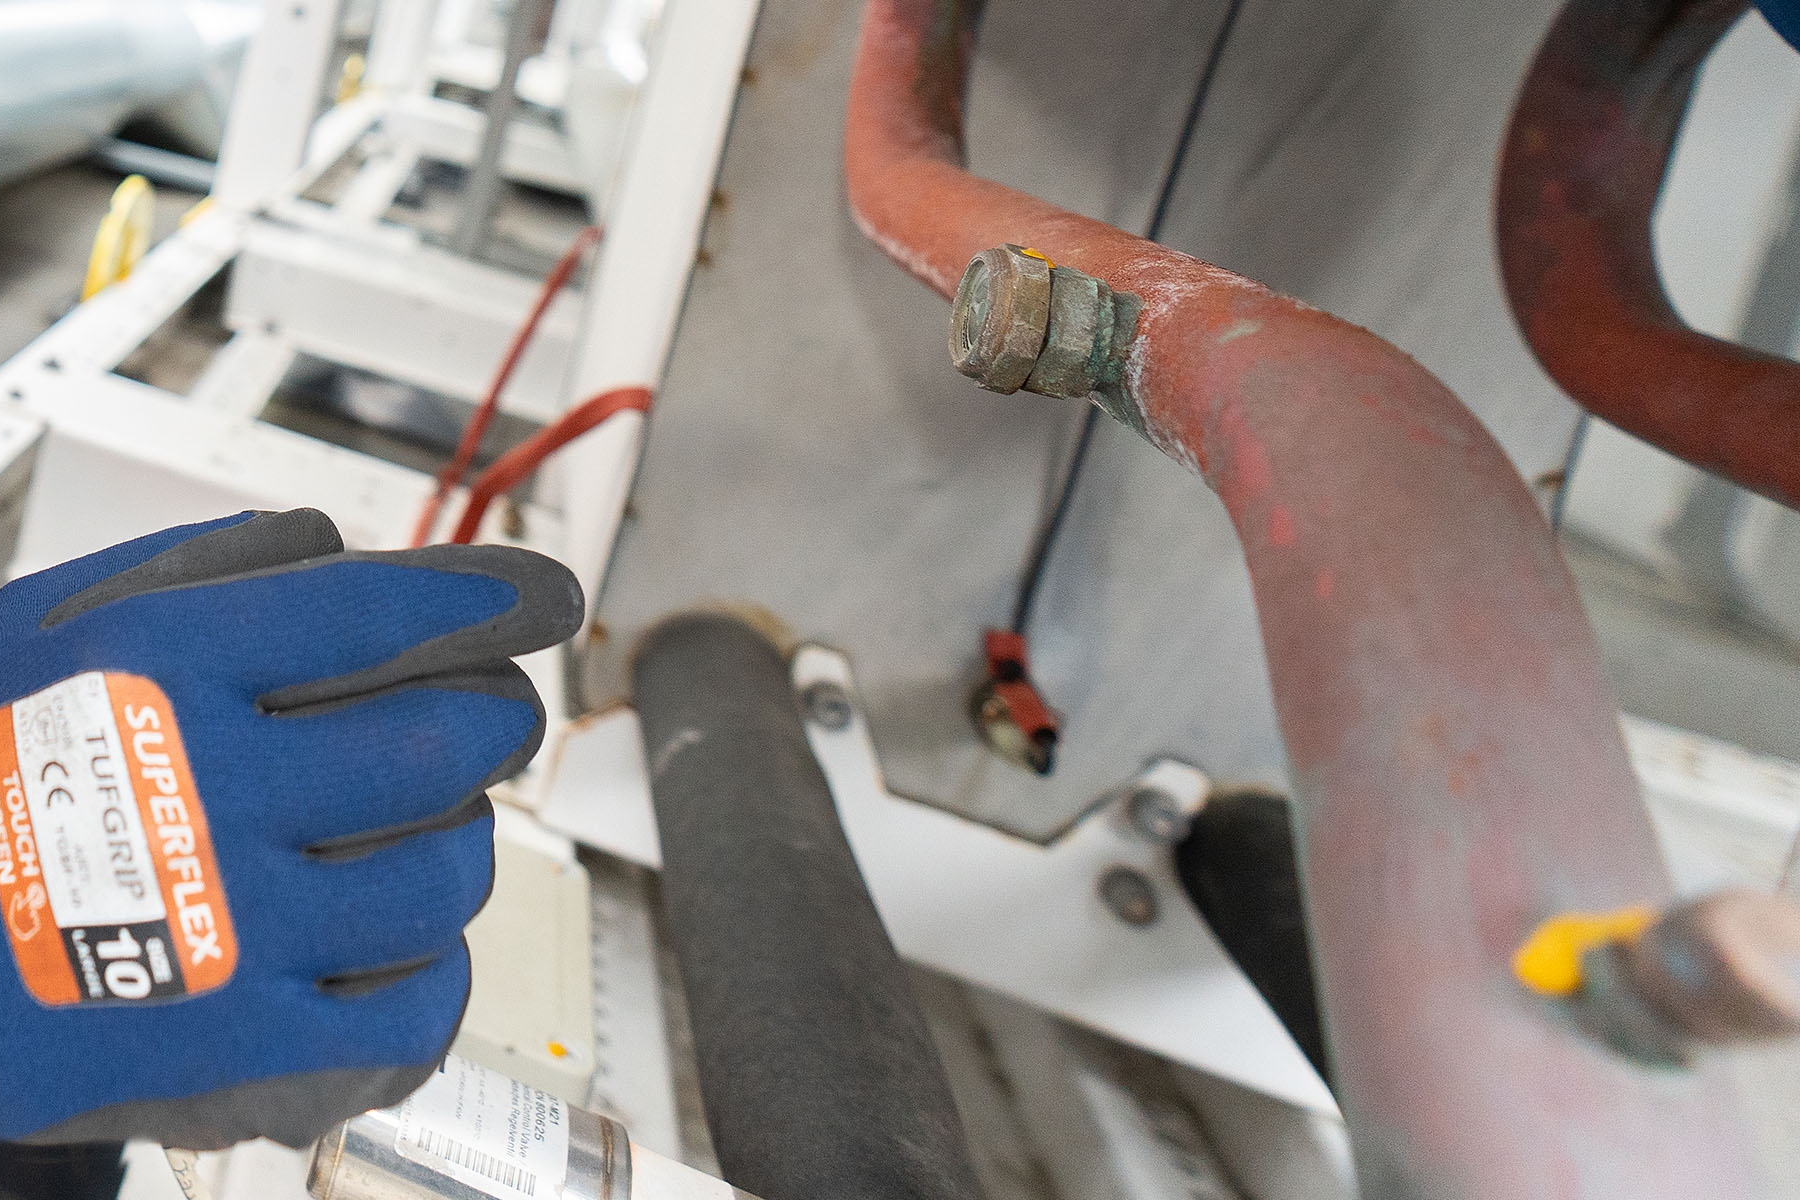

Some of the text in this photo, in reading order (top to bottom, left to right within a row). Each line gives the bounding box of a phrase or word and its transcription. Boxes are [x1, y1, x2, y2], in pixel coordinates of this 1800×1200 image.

[1, 769, 41, 879] TOUCH
[84, 731, 145, 902] TUFGRIP
[124, 702, 223, 965] SUPERFLEX
[96, 927, 152, 999] 10
[534, 1101, 546, 1142] 800625
